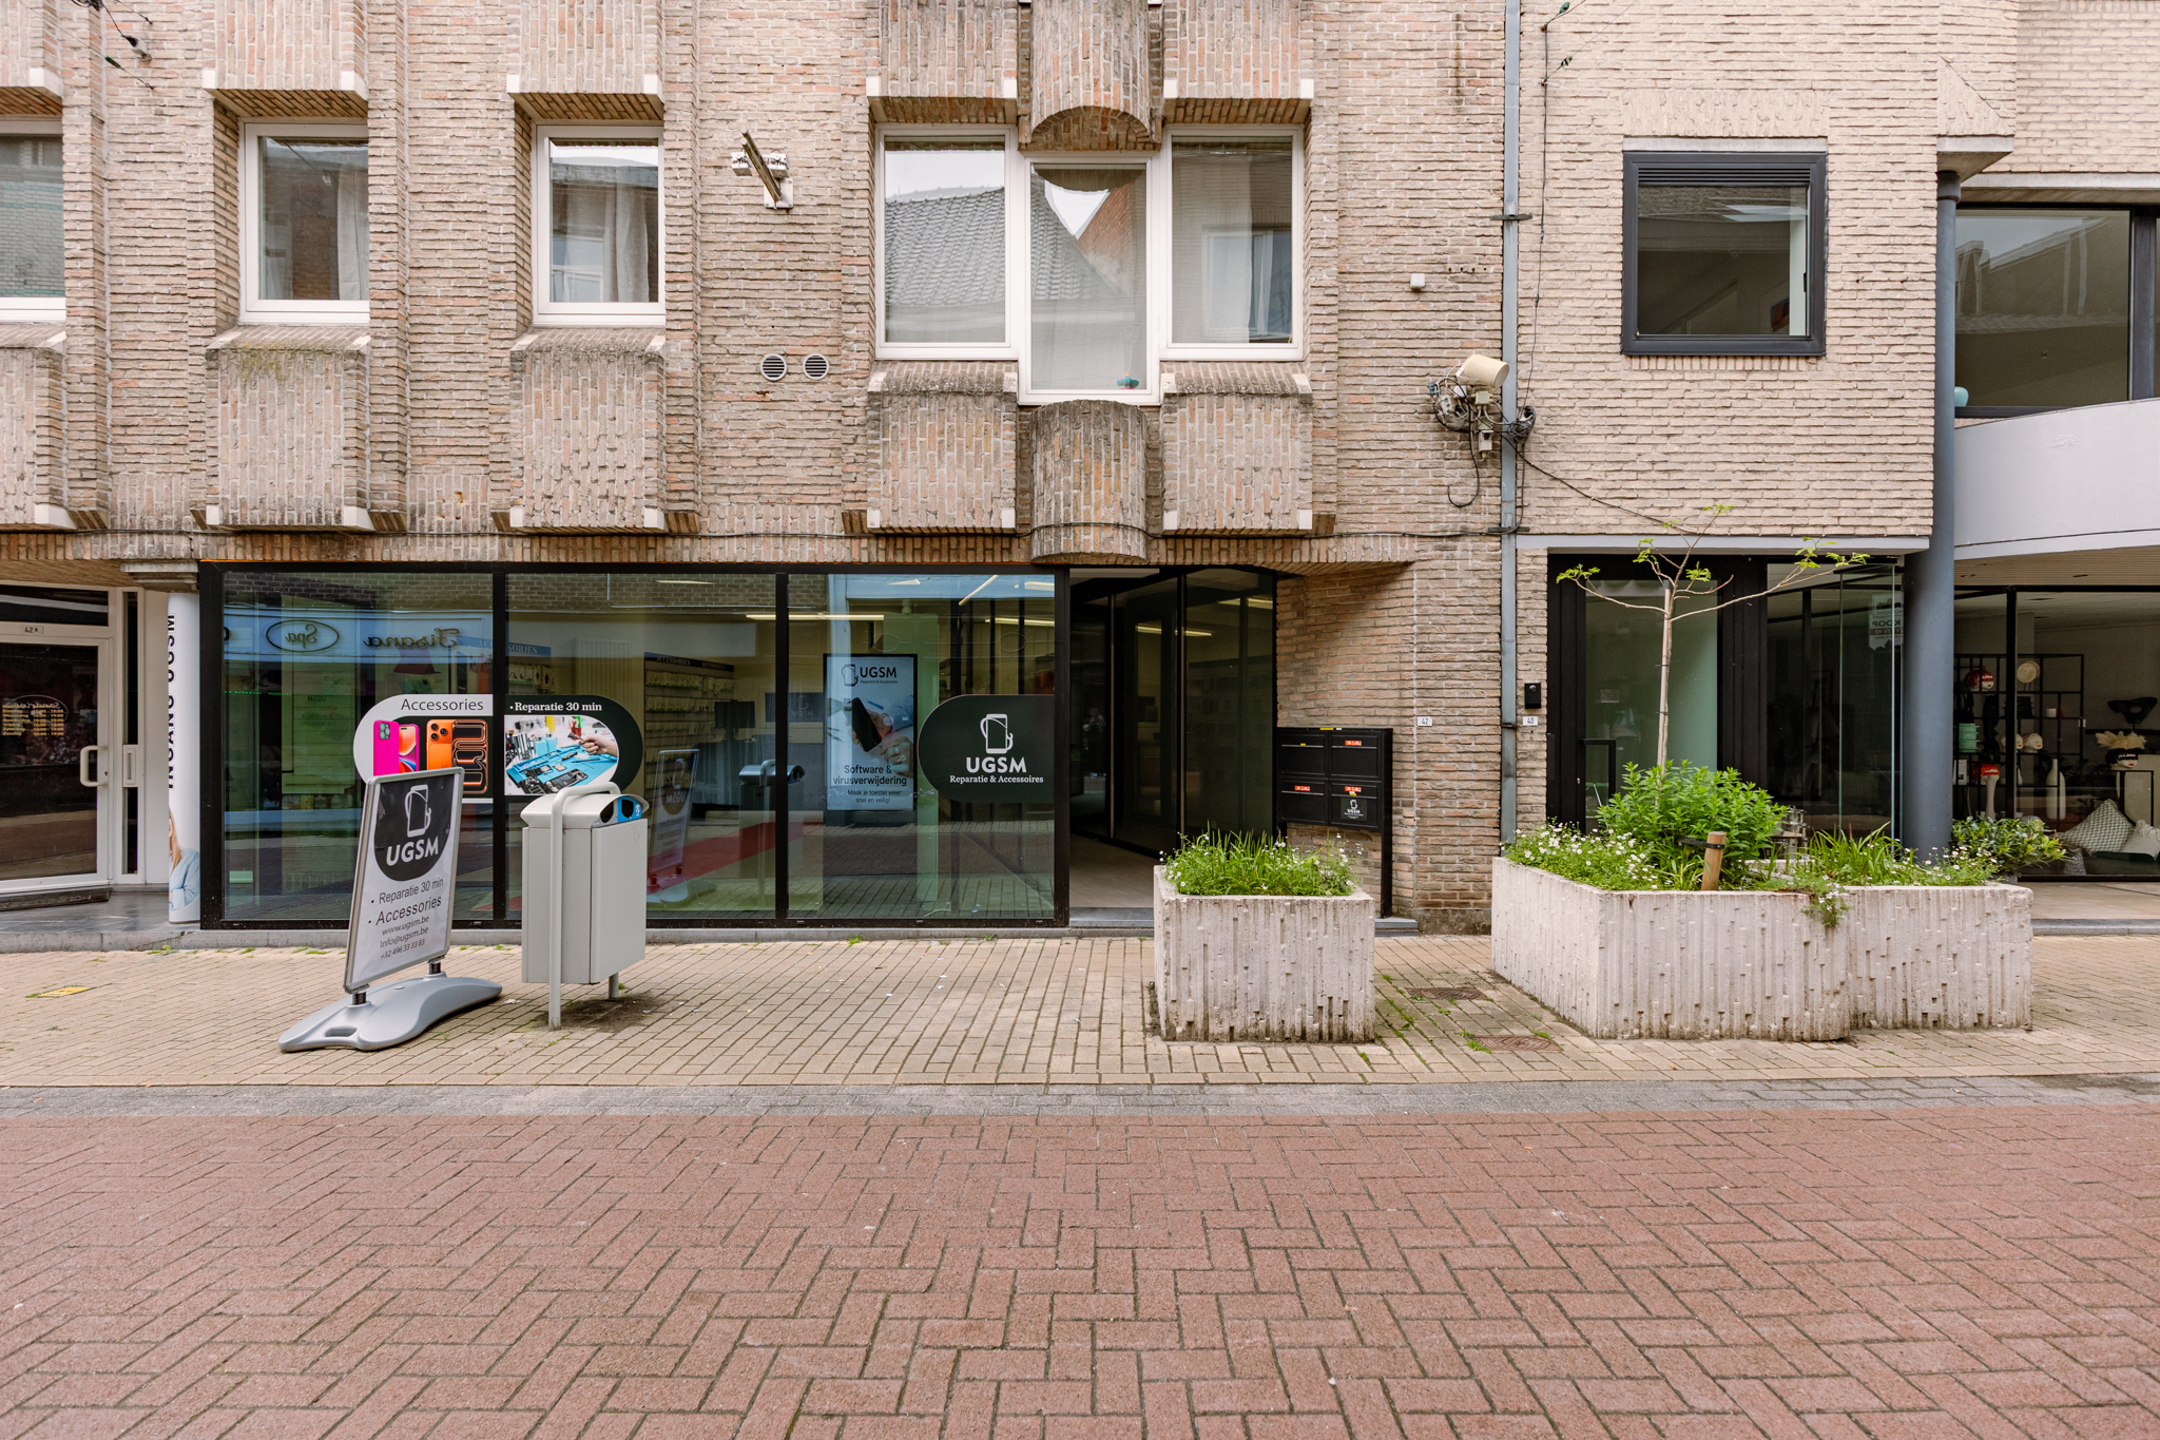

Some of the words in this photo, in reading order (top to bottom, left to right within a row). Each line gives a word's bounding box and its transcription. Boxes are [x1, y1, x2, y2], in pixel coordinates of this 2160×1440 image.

[860, 666, 897, 679] UGSM
[401, 698, 484, 712] Accessories
[514, 702, 564, 714] Reparatie
[565, 702, 580, 711] 30
[581, 702, 602, 711] min
[844, 764, 884, 774] Software
[885, 764, 892, 774] &
[966, 756, 1027, 773] UGSM
[833, 775, 907, 787] virusverwijdering
[949, 775, 987, 785] Reparatie
[989, 775, 997, 783] &
[997, 775, 1044, 783] Accessoires
[863, 789, 869, 797] je
[386, 836, 439, 866] UGSM
[379, 884, 419, 905] Reparatie
[420, 880, 431, 893] 30
[431, 877, 444, 890] min
[375, 896, 442, 926] Accessories
[382, 915, 430, 936] www.ugsm.be
[380, 926, 429, 949] Info@ugsm.be
[380, 950, 392, 959] +32
